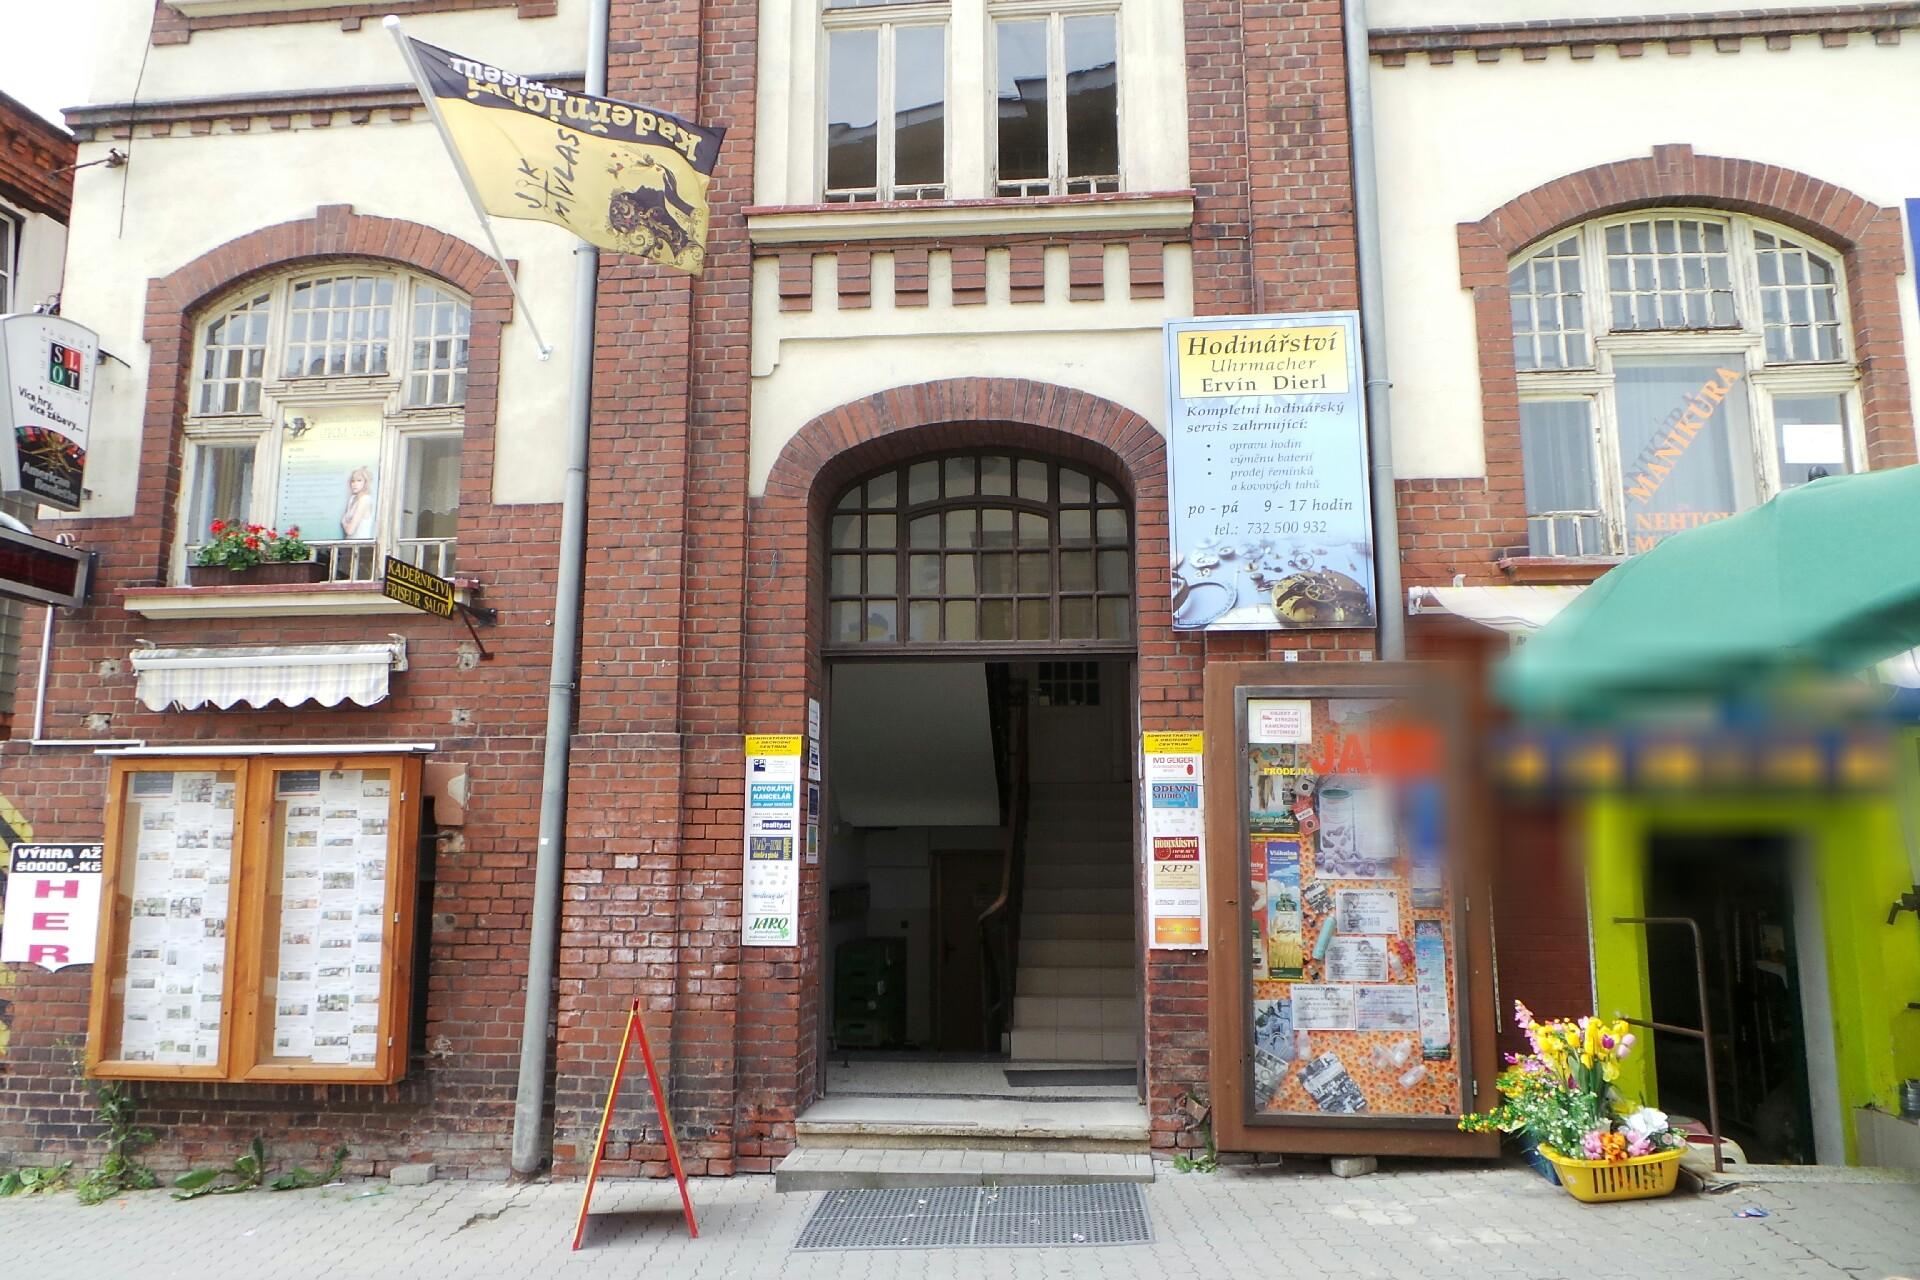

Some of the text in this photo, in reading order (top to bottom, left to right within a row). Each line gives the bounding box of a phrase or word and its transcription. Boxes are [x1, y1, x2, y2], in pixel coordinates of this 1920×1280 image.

[1188, 332, 1339, 356] Hodinářství
[1211, 357, 1317, 373] Uhrmacher
[1202, 374, 1327, 393] Ervín Dierl
[1187, 401, 1344, 418] Kompletní hodinářský
[1187, 418, 1308, 434] servis zahrnující:
[1229, 439, 1302, 453] opravu hodin
[1230, 456, 1274, 467] výměnu
[1230, 468, 1264, 480] prodej
[1188, 504, 1205, 518] po
[1221, 500, 1239, 517] pá
[1264, 500, 1272, 512] 9
[1290, 499, 1306, 512] 17
[1312, 498, 1353, 511] hodin
[1247, 522, 1270, 534] 732
[1274, 522, 1298, 534] 500
[1303, 521, 1327, 533] 932
[386, 582, 420, 607] FRISEUR
[1263, 768, 1314, 776] PRODEJNA
[18, 846, 102, 859] VÝHRA AŽ
[1160, 864, 1194, 872] KFP
[749, 917, 789, 930] JARO
